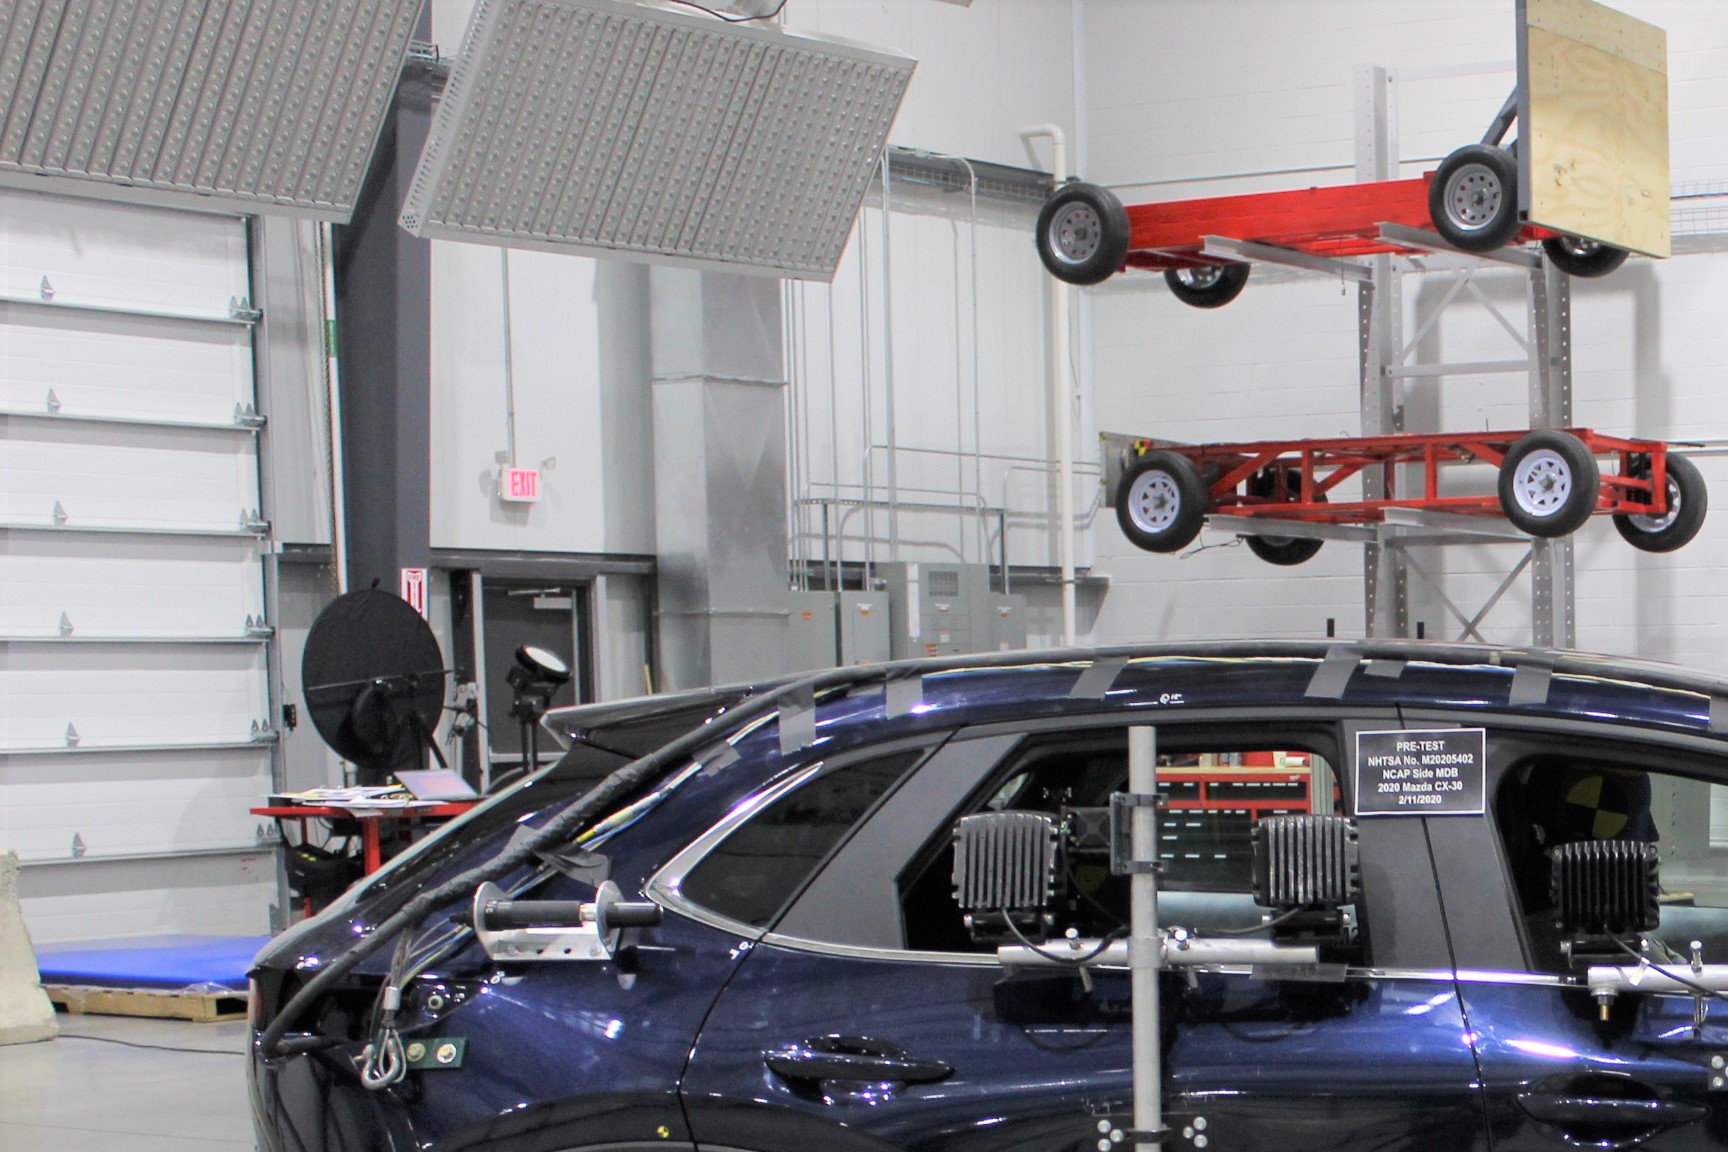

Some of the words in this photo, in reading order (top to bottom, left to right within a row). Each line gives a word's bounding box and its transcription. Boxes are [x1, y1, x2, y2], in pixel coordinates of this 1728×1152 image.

[511, 471, 537, 497] EXIT
[1396, 741, 1445, 752] PRE-TEST
[1367, 756, 1402, 766] NHTSA
[1403, 755, 1420, 766] No.
[1421, 754, 1474, 765] M20205402
[1382, 769, 1411, 779] NCAP
[1412, 768, 1434, 779] Side
[1435, 767, 1458, 778] MDB
[1377, 783, 1400, 792] 2020
[1402, 782, 1432, 792] Mazda
[1434, 781, 1463, 791] CX-30
[1398, 795, 1442, 805] 2/11/2020
